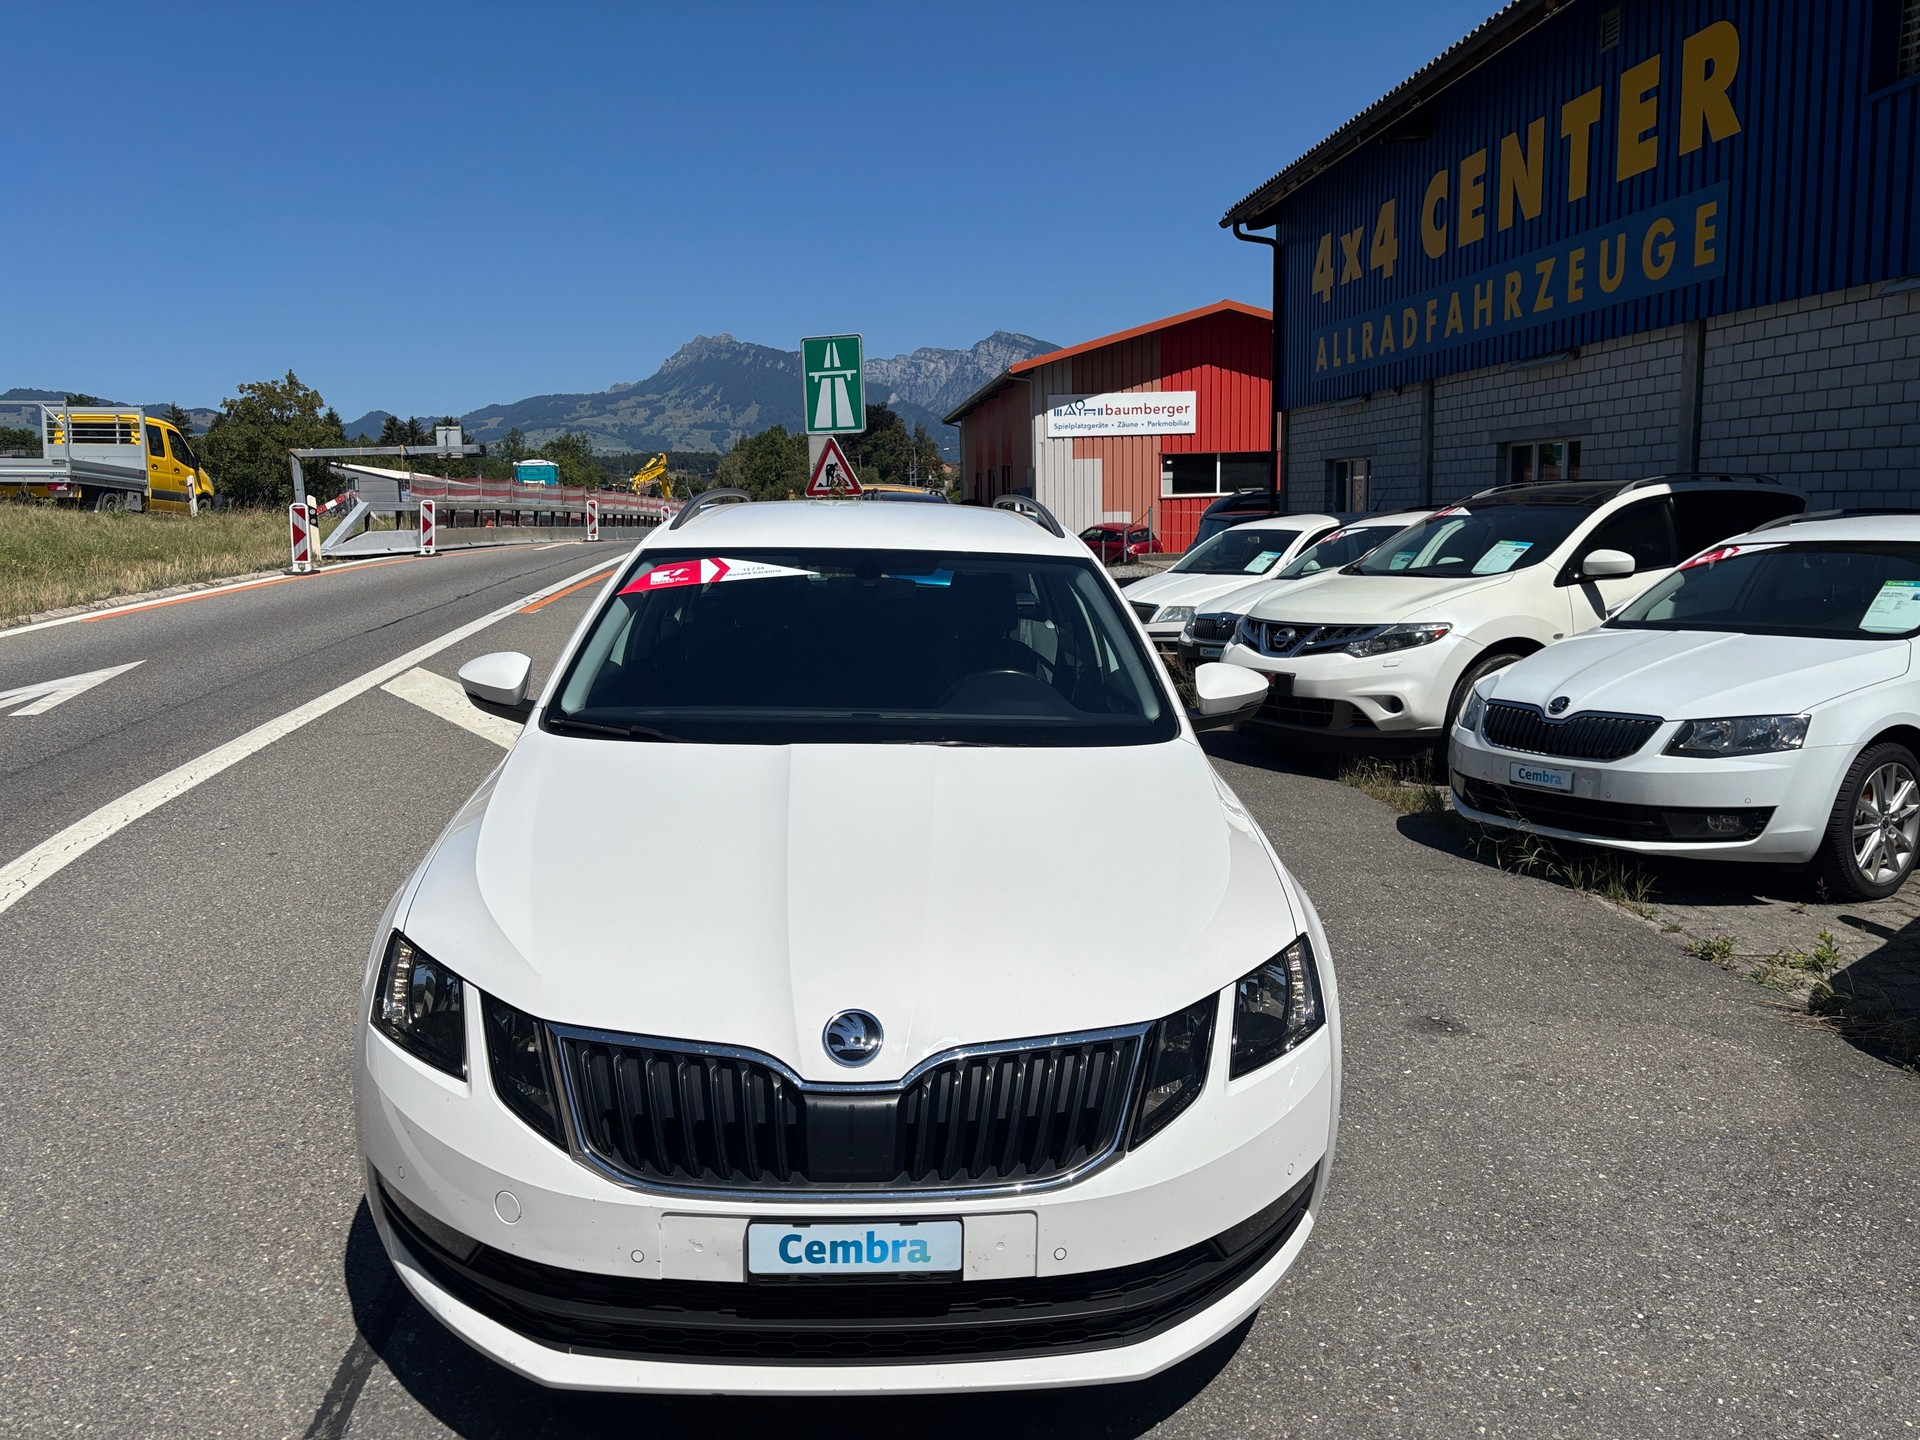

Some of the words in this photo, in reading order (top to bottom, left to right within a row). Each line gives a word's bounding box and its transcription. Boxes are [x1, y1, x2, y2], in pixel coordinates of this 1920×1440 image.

[1311, 199, 1399, 303] 4x4
[1421, 20, 1742, 259] CENTER
[1315, 201, 1717, 373] ALLRADFAHRZEUGE
[1105, 403, 1190, 417] baumberger
[1054, 422, 1109, 431] Spielplatzgeräte
[1147, 420, 1190, 428] Parkmobiliar
[1518, 768, 1563, 785] Cembra
[779, 1231, 931, 1264] Cembra
